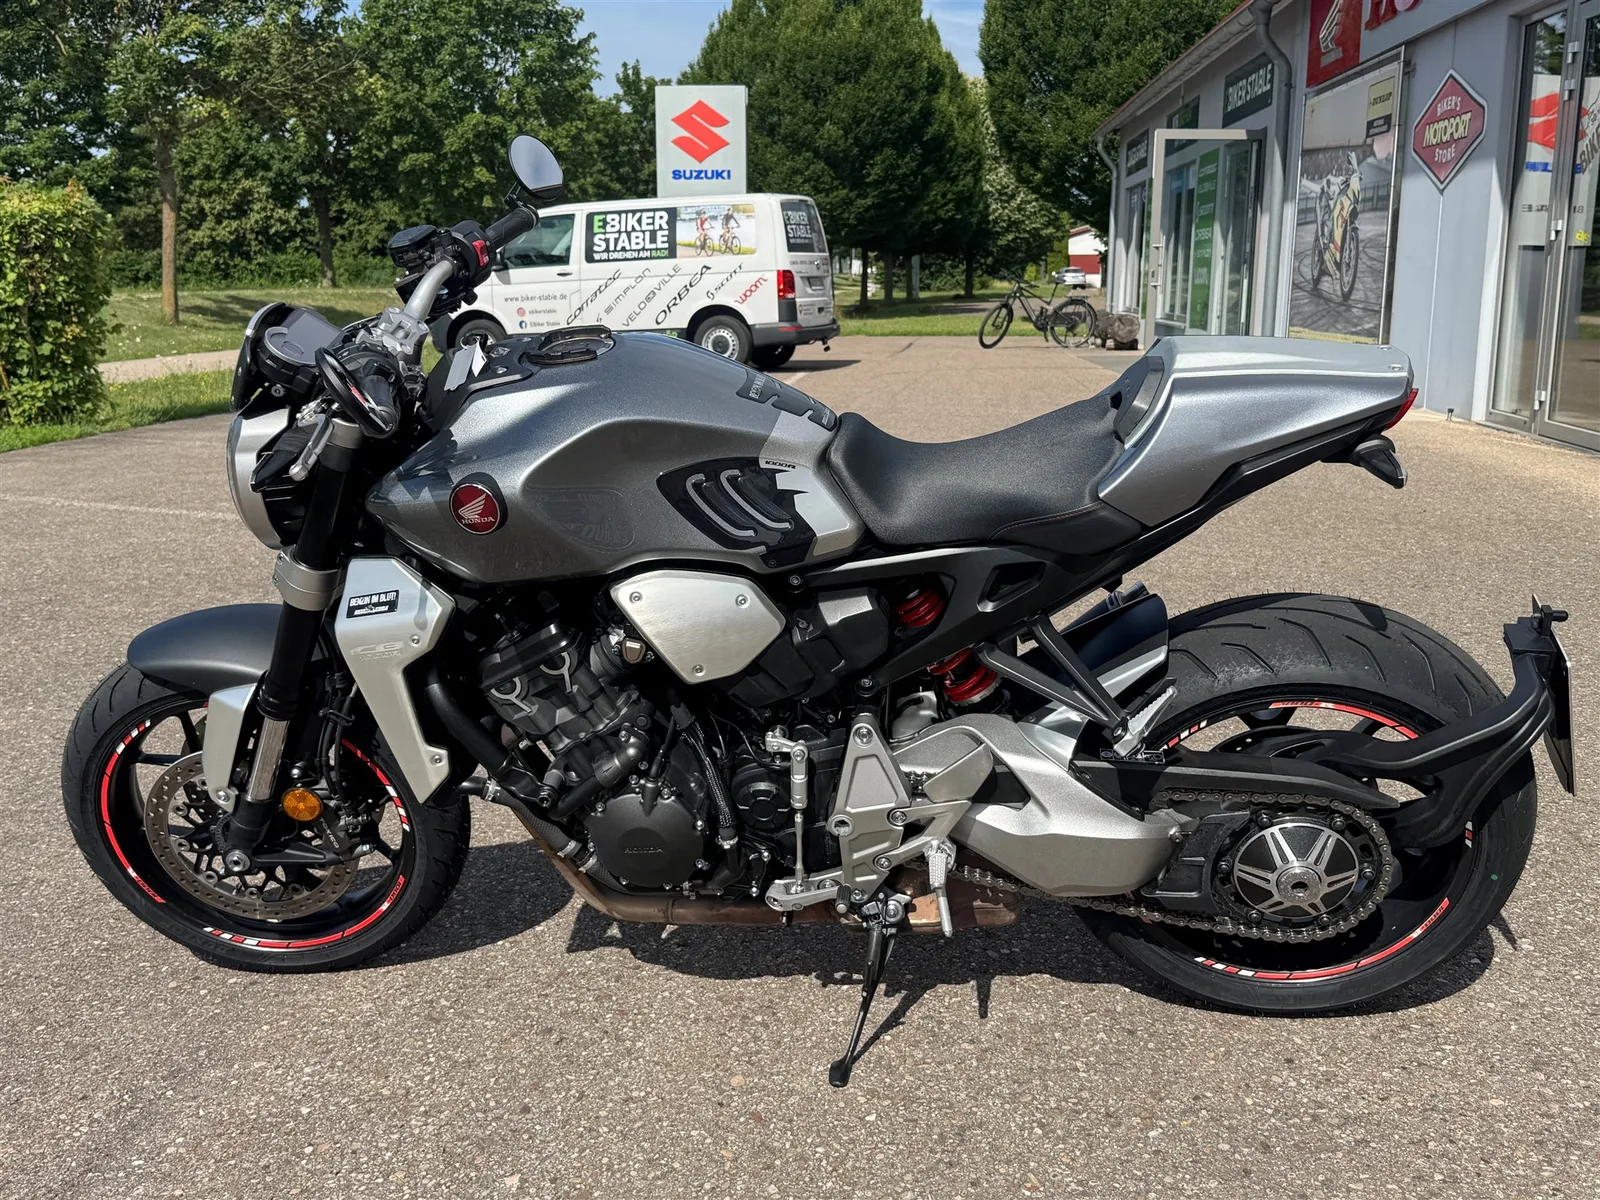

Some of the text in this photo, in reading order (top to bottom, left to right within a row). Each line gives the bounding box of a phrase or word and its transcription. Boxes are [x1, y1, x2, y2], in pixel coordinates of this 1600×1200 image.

[1246, 63, 1273, 101] STABLE
[1436, 95, 1461, 116] BIKER'S
[1422, 110, 1472, 148] MOTOPORT
[1434, 143, 1456, 163] STORE
[671, 169, 731, 181] SUZUKI
[593, 211, 669, 233] EBIKER
[787, 225, 812, 238] STABLE
[593, 230, 669, 252] STABLE
[593, 249, 669, 261] WIR DREHEN AM RAD!
[714, 261, 744, 294] SCOTT
[504, 293, 567, 302] www.biker-stable.de
[566, 268, 621, 326] corratec
[655, 264, 712, 326] ORBEA
[461, 516, 496, 525] HONDA
[371, 594, 379, 604] IM
[379, 591, 397, 602] BLUT!
